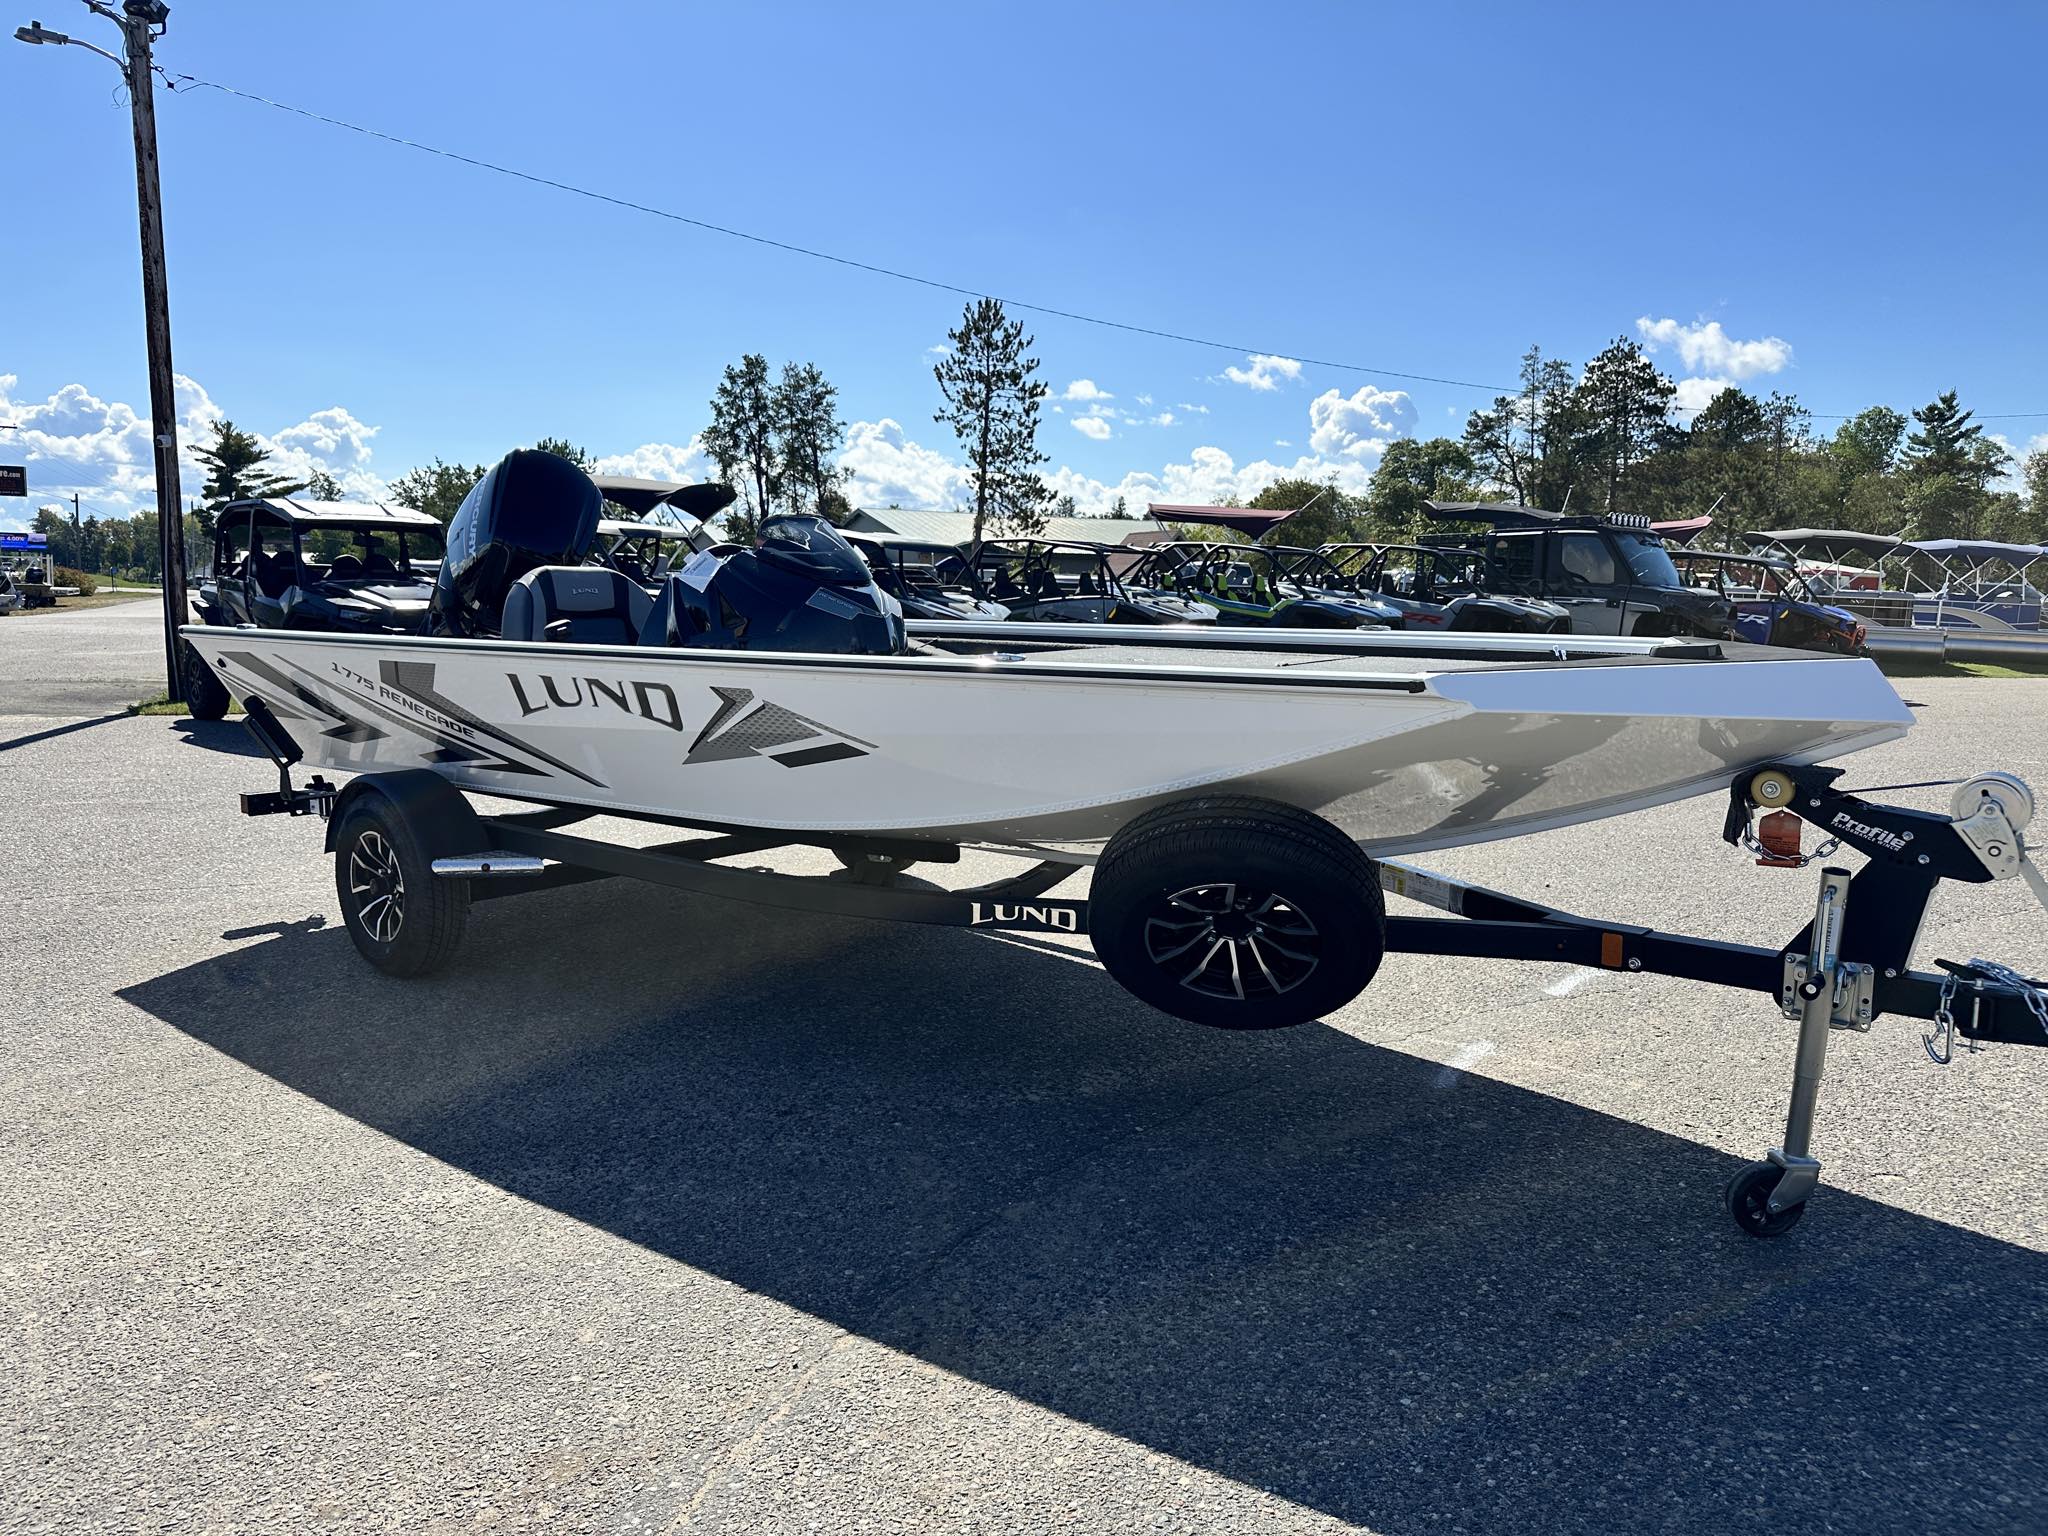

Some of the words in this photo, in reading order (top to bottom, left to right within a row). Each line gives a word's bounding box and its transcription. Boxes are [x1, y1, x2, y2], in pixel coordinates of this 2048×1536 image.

[331, 661, 375, 691] 1775
[379, 685, 476, 740] RENEGADE
[504, 672, 684, 732] LUND
[1831, 821, 1877, 842] PERFORMANCE
[1877, 840, 1901, 852] WINCH
[1832, 811, 1906, 848] Profile
[970, 902, 1077, 932] LUND
